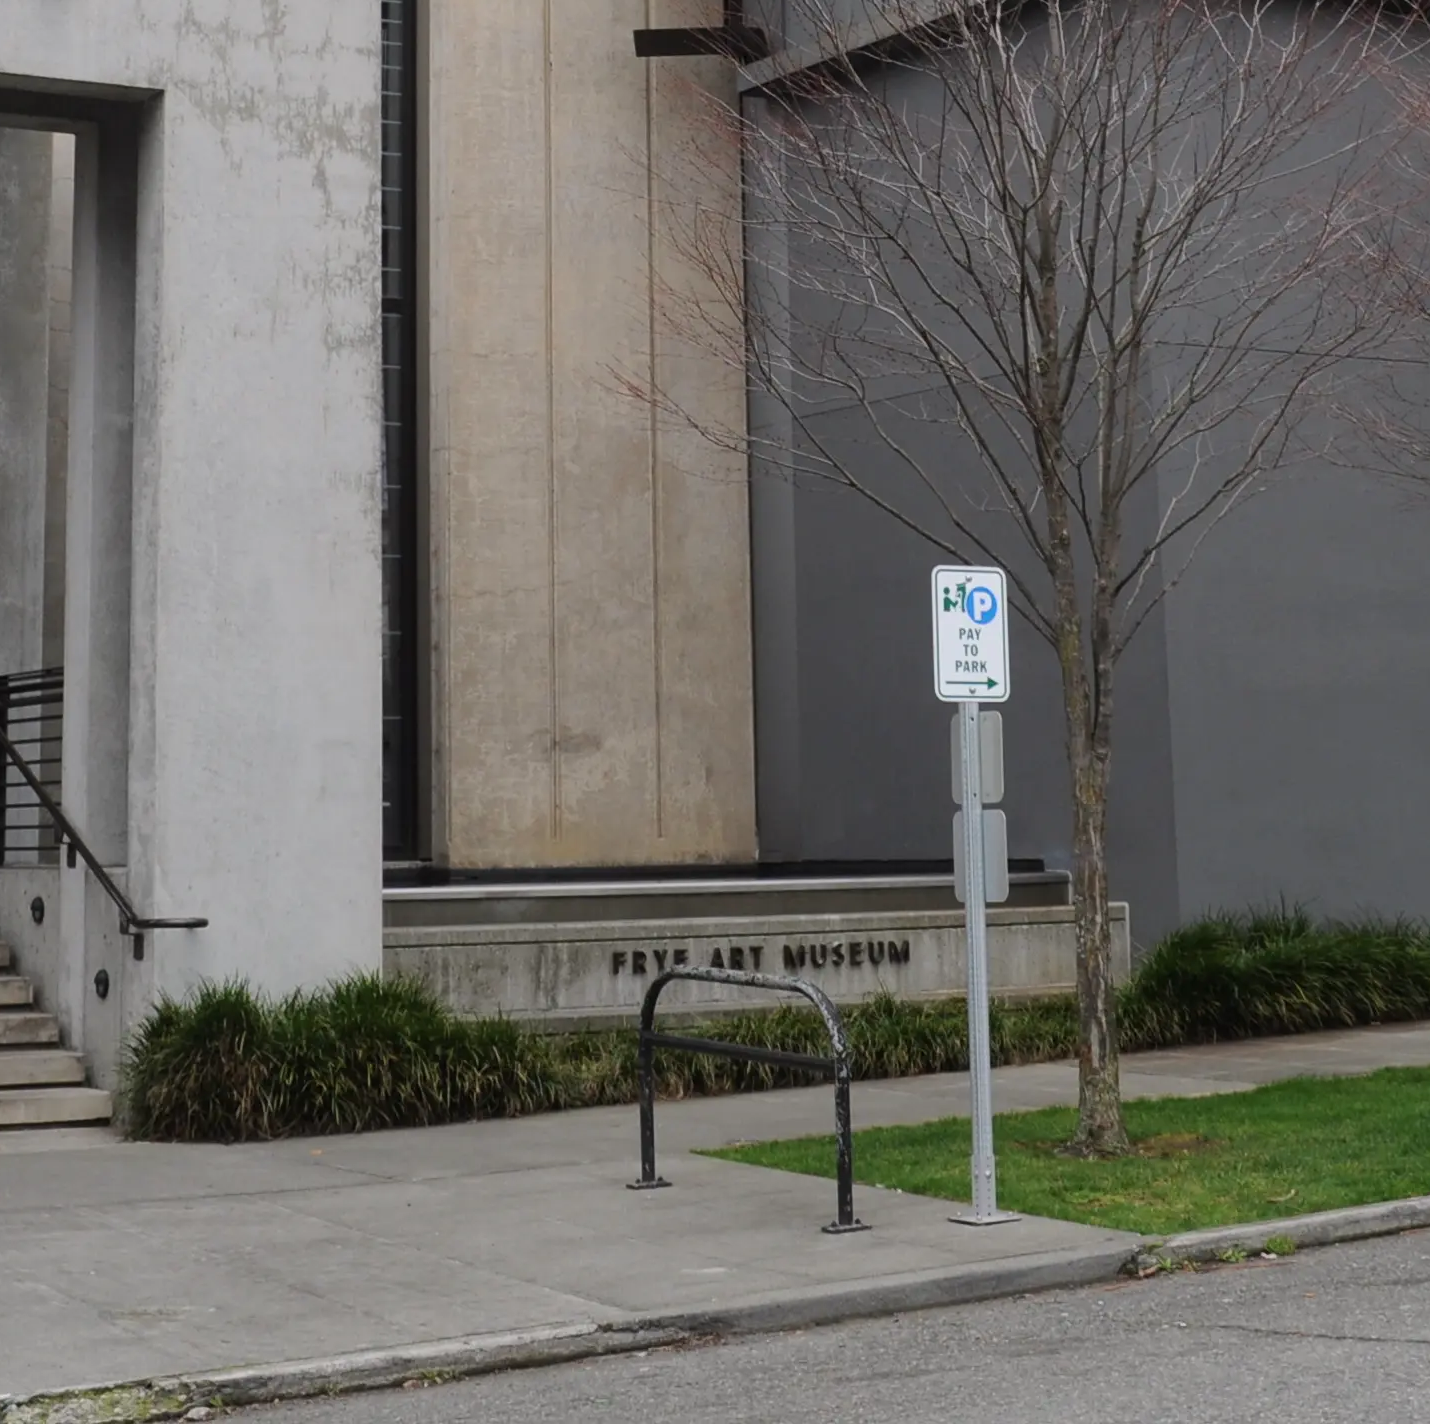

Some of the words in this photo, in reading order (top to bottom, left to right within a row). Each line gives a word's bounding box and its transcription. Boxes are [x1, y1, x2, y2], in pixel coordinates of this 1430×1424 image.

[972, 590, 993, 622] P
[958, 627, 982, 641] PAY
[962, 644, 979, 657] TO
[955, 660, 988, 673] PARK
[612, 948, 689, 975] FRYE
[709, 945, 765, 971] ART
[783, 939, 912, 970] MUSEUM
